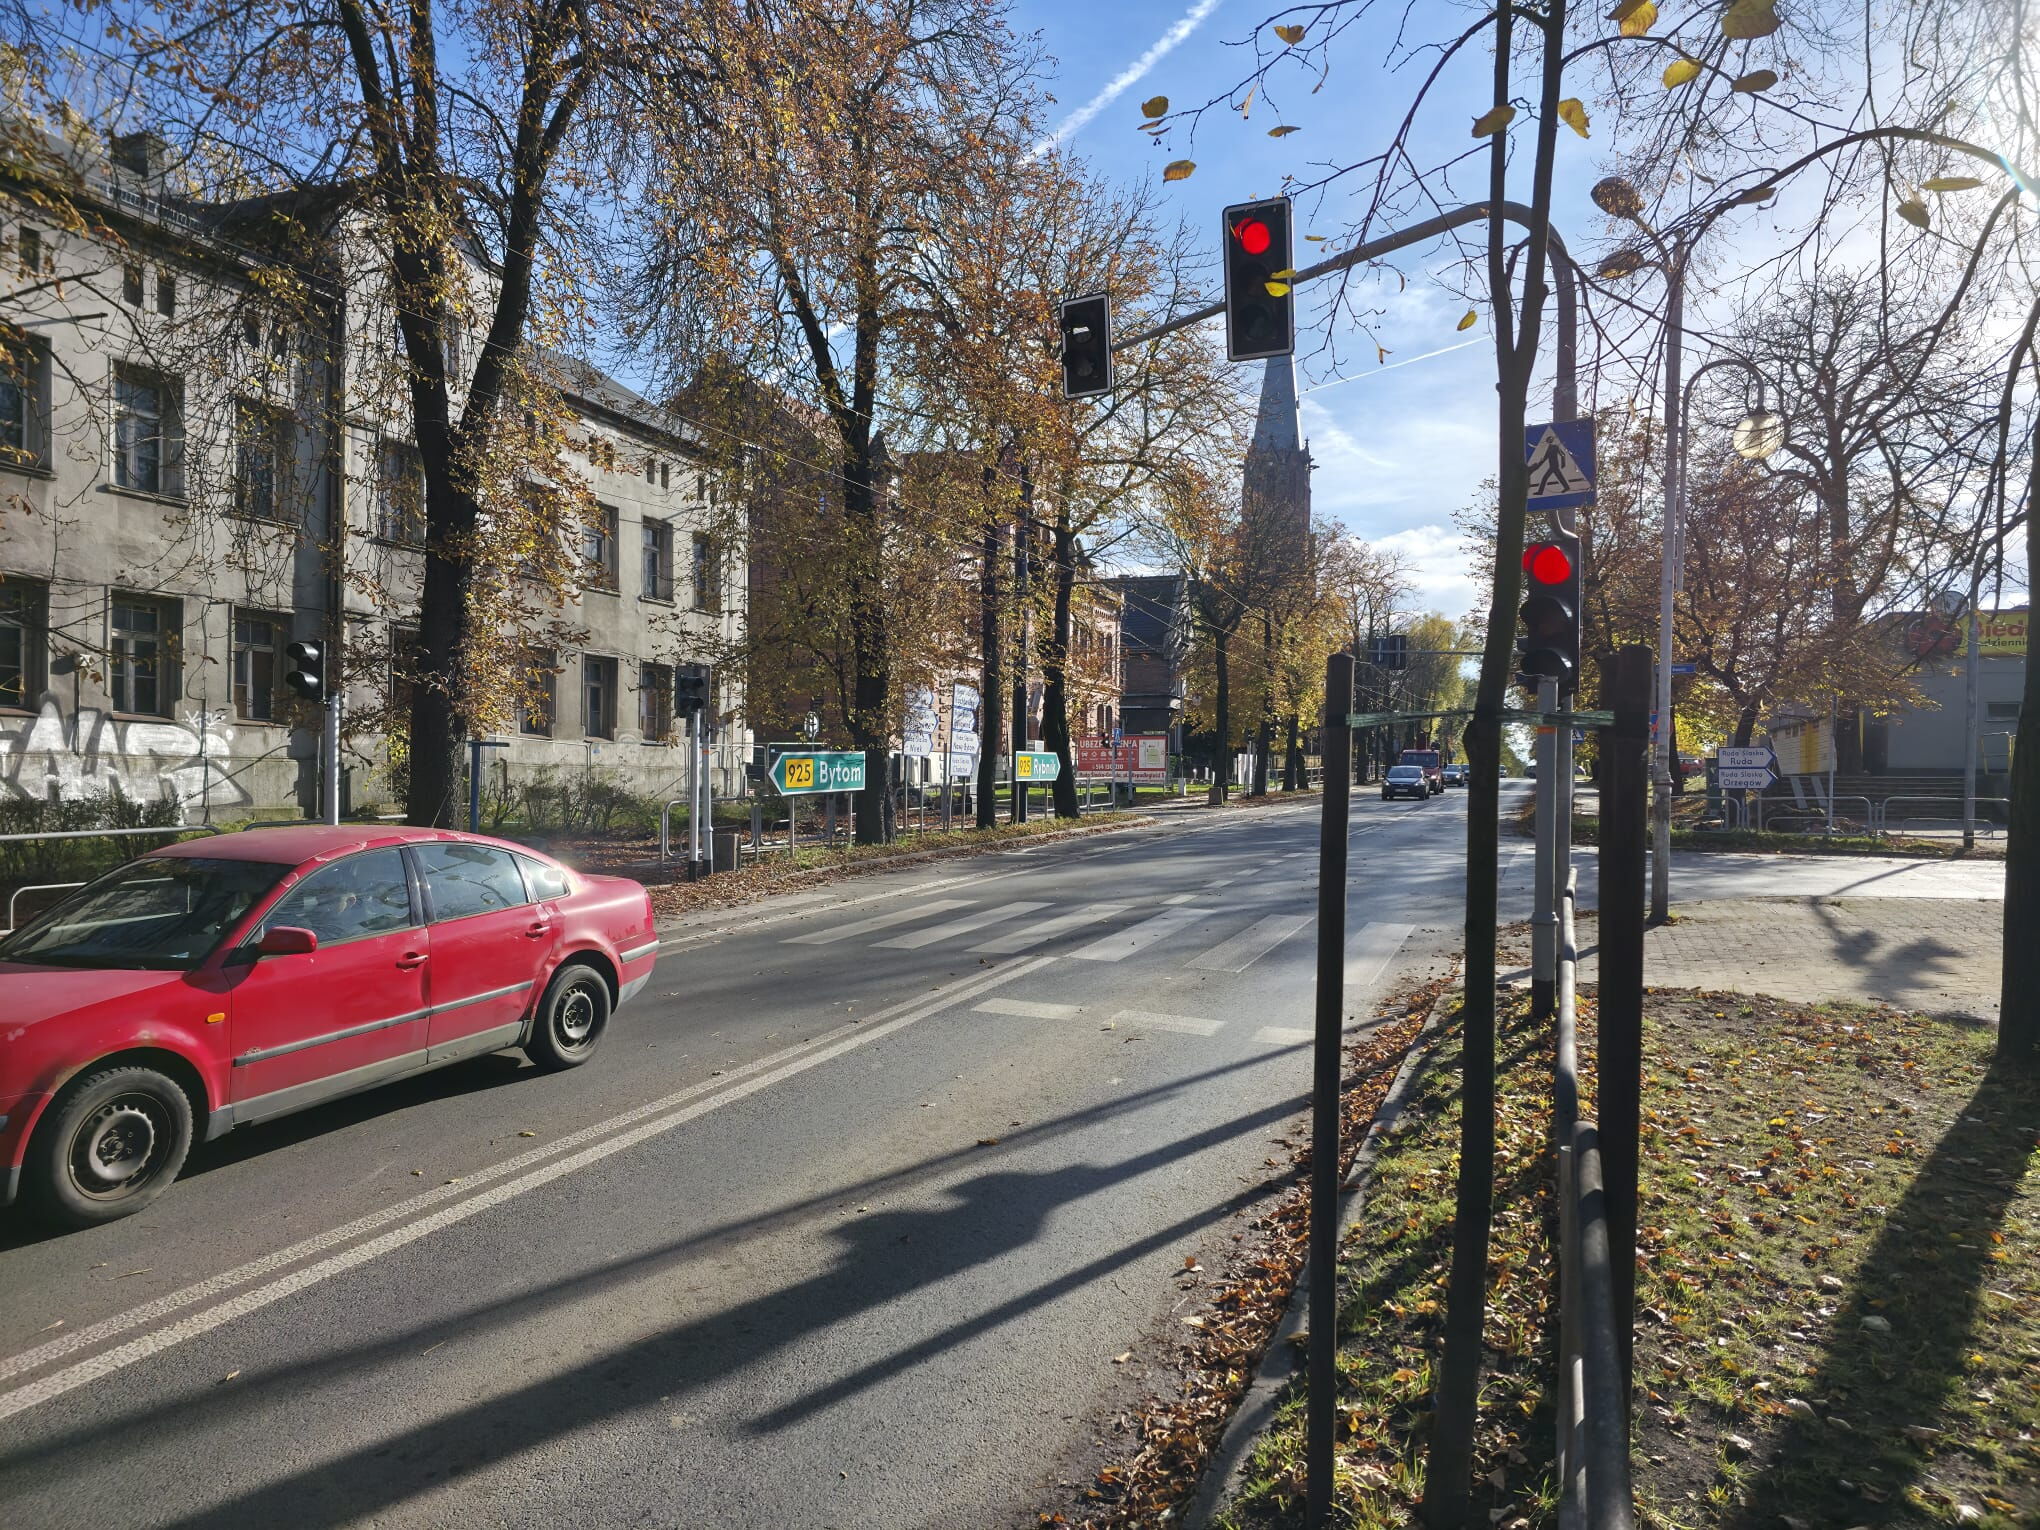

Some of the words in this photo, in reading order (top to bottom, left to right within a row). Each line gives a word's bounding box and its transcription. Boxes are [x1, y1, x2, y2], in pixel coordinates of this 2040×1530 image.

[1019, 759, 1032, 774] 925
[1033, 758, 1056, 779] Rybnik
[1730, 757, 1753, 765] Ruda
[788, 764, 811, 783] 925
[819, 760, 861, 790] Bytom
